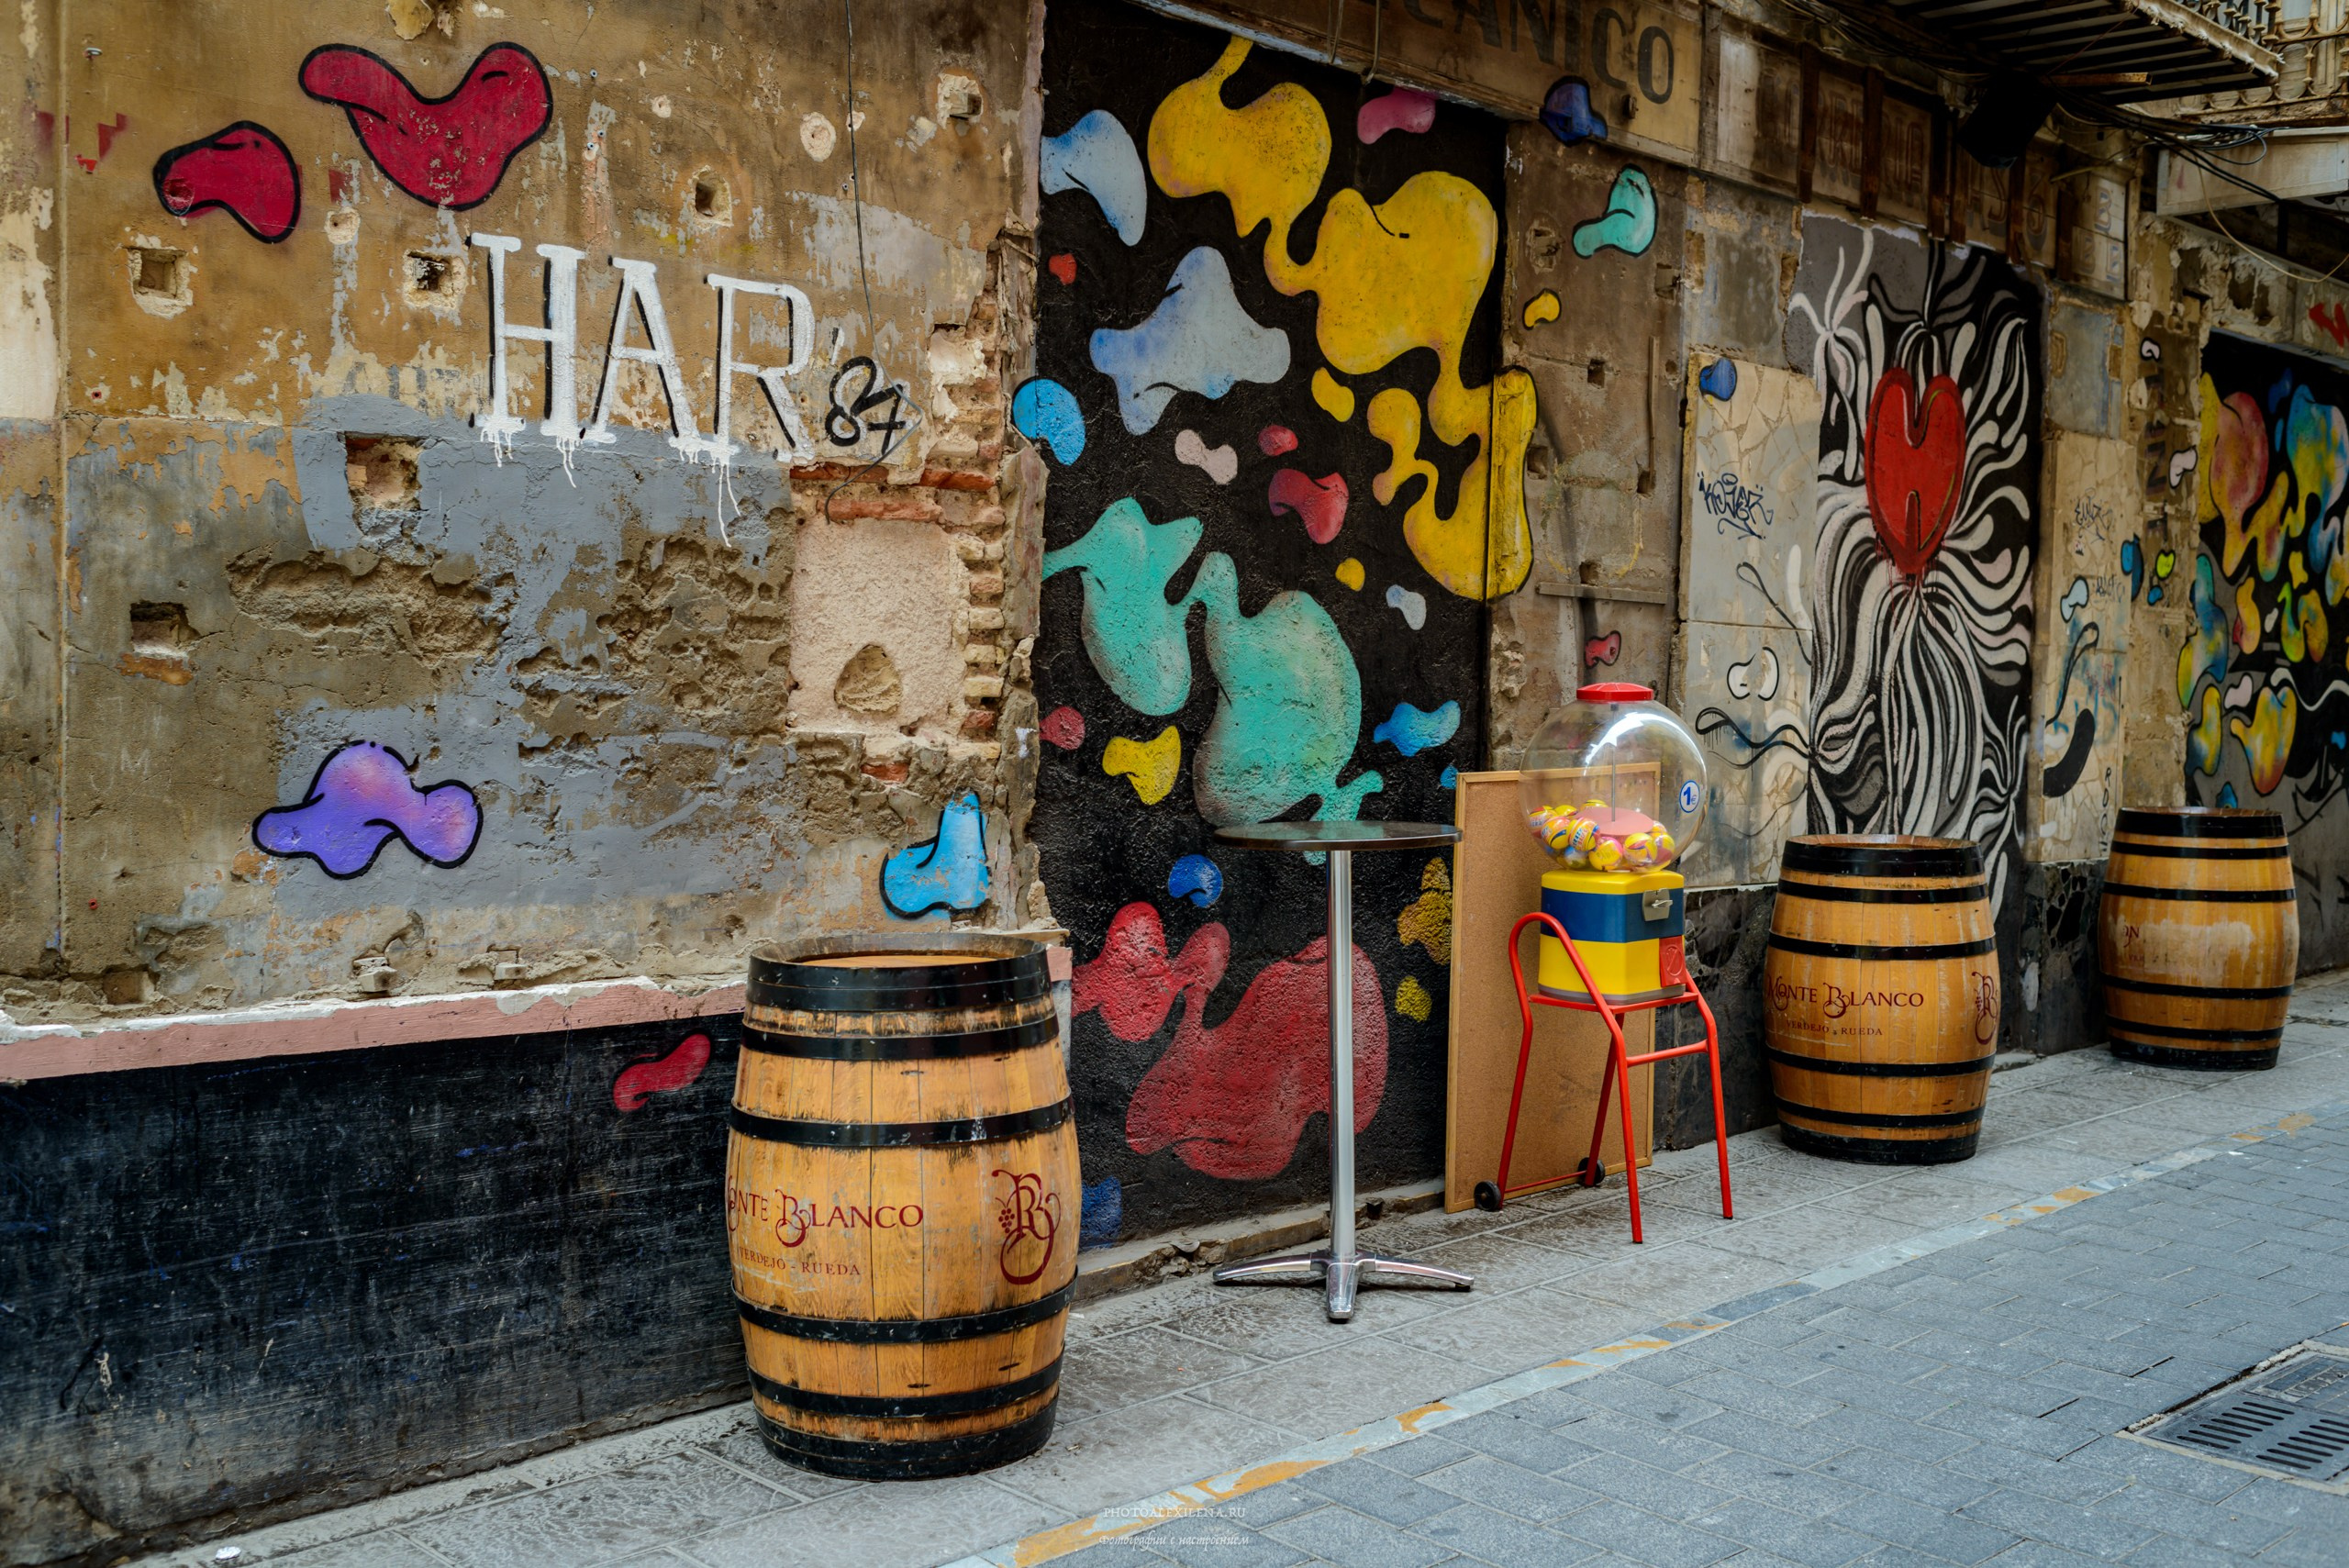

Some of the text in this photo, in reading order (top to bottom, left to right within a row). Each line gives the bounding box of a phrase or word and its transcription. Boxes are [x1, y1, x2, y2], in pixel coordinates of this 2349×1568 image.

[464, 232, 815, 465] HAR
[1823, 982, 1924, 1019] BLANCO
[1786, 1020, 1830, 1033] VERDEJO
[1841, 1027, 1884, 1036] RUEDA
[774, 1188, 924, 1248] BLANCO
[740, 1246, 786, 1270] VERDEJO
[801, 1261, 862, 1276] RUEDA
